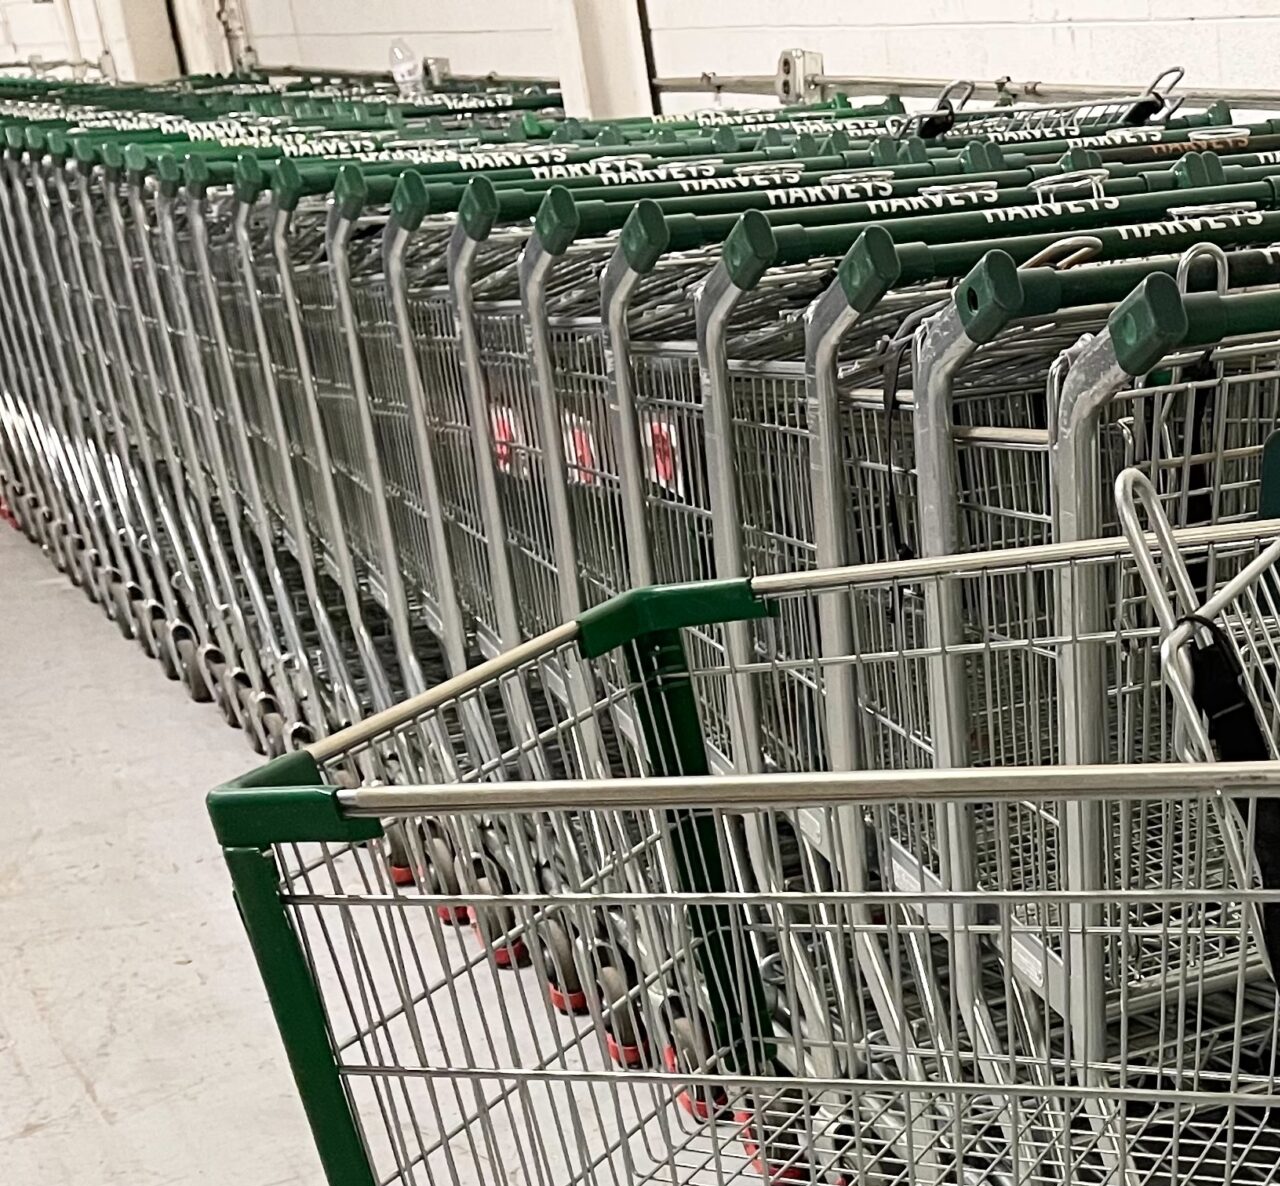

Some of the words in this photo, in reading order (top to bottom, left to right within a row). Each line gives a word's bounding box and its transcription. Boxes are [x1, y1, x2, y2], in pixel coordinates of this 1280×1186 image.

[460, 148, 567, 170] HARVEYS
[531, 159, 644, 180] HARVEYS
[600, 166, 716, 185] HARVEYS
[681, 171, 801, 192] HARVEYS
[765, 181, 894, 205] HARVEYS
[864, 190, 999, 214] HARVEYS
[981, 196, 1120, 223] HARVEYS
[1117, 212, 1264, 240] HARVEYS
